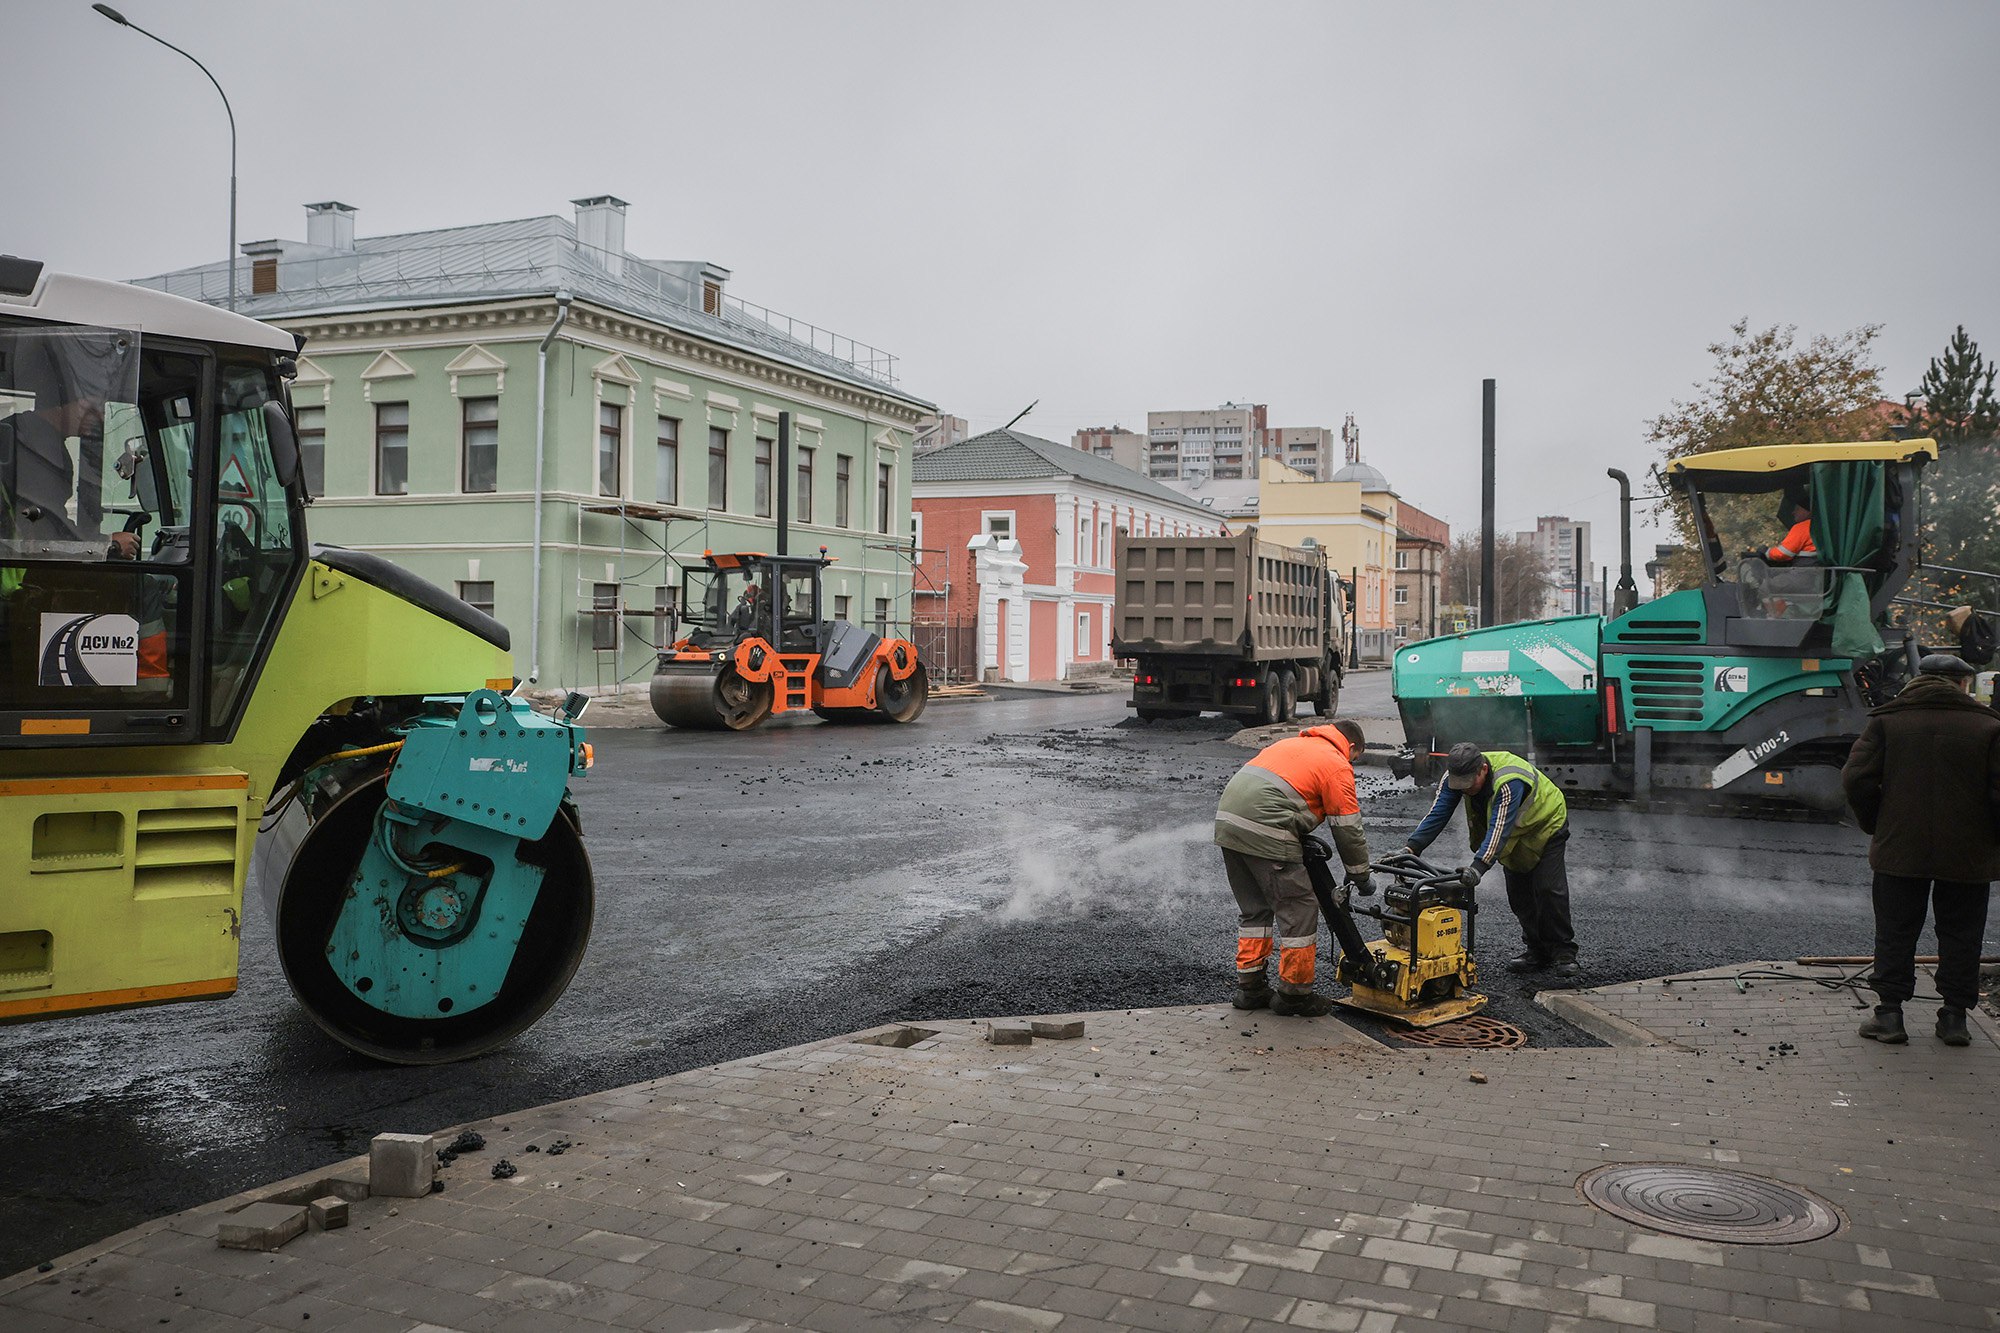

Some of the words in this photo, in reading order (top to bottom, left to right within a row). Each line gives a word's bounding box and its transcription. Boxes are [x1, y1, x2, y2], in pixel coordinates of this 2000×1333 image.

[221, 510, 243, 525] 40
[81, 635, 110, 651] ДСУ
[112, 636, 135, 650] №2
[1749, 731, 1790, 760] 1900-2
